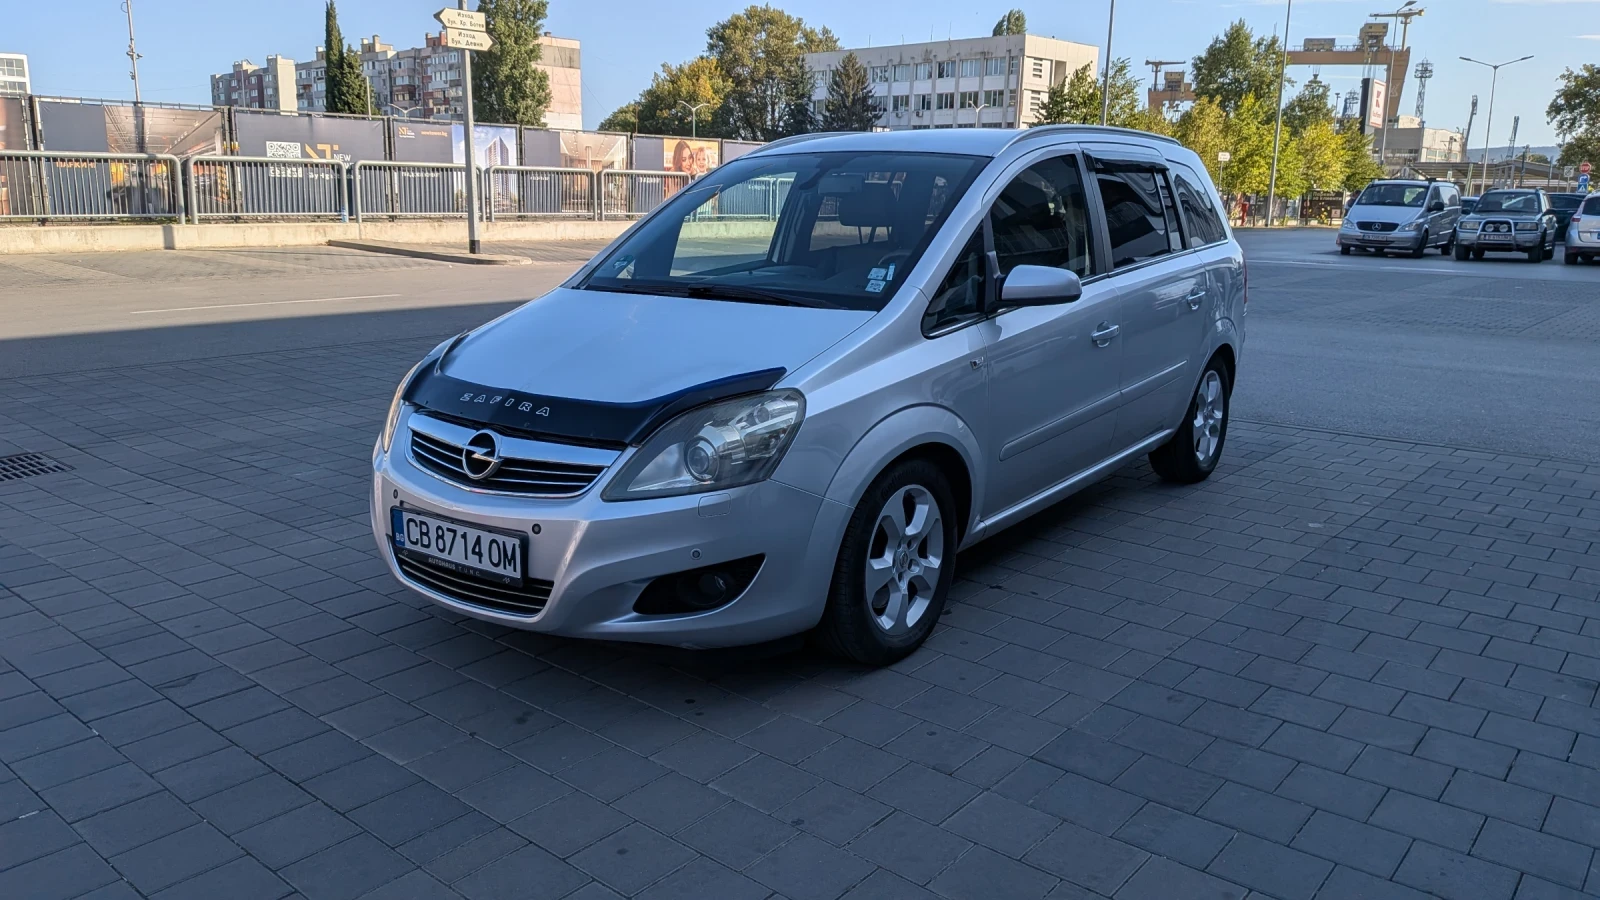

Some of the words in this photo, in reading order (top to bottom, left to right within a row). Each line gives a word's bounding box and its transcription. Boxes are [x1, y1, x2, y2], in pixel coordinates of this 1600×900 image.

[457, 12, 474, 20] Изход
[458, 31, 476, 40] Изход
[465, 40, 483, 48] Девня
[333, 153, 352, 162] NEW
[459, 392, 550, 416] ZAFIRA
[395, 532, 405, 542] BG
[406, 517, 432, 549] CB
[435, 524, 484, 565] 8714
[488, 538, 517, 573] OM
[428, 557, 456, 570] AUTOHAUS
